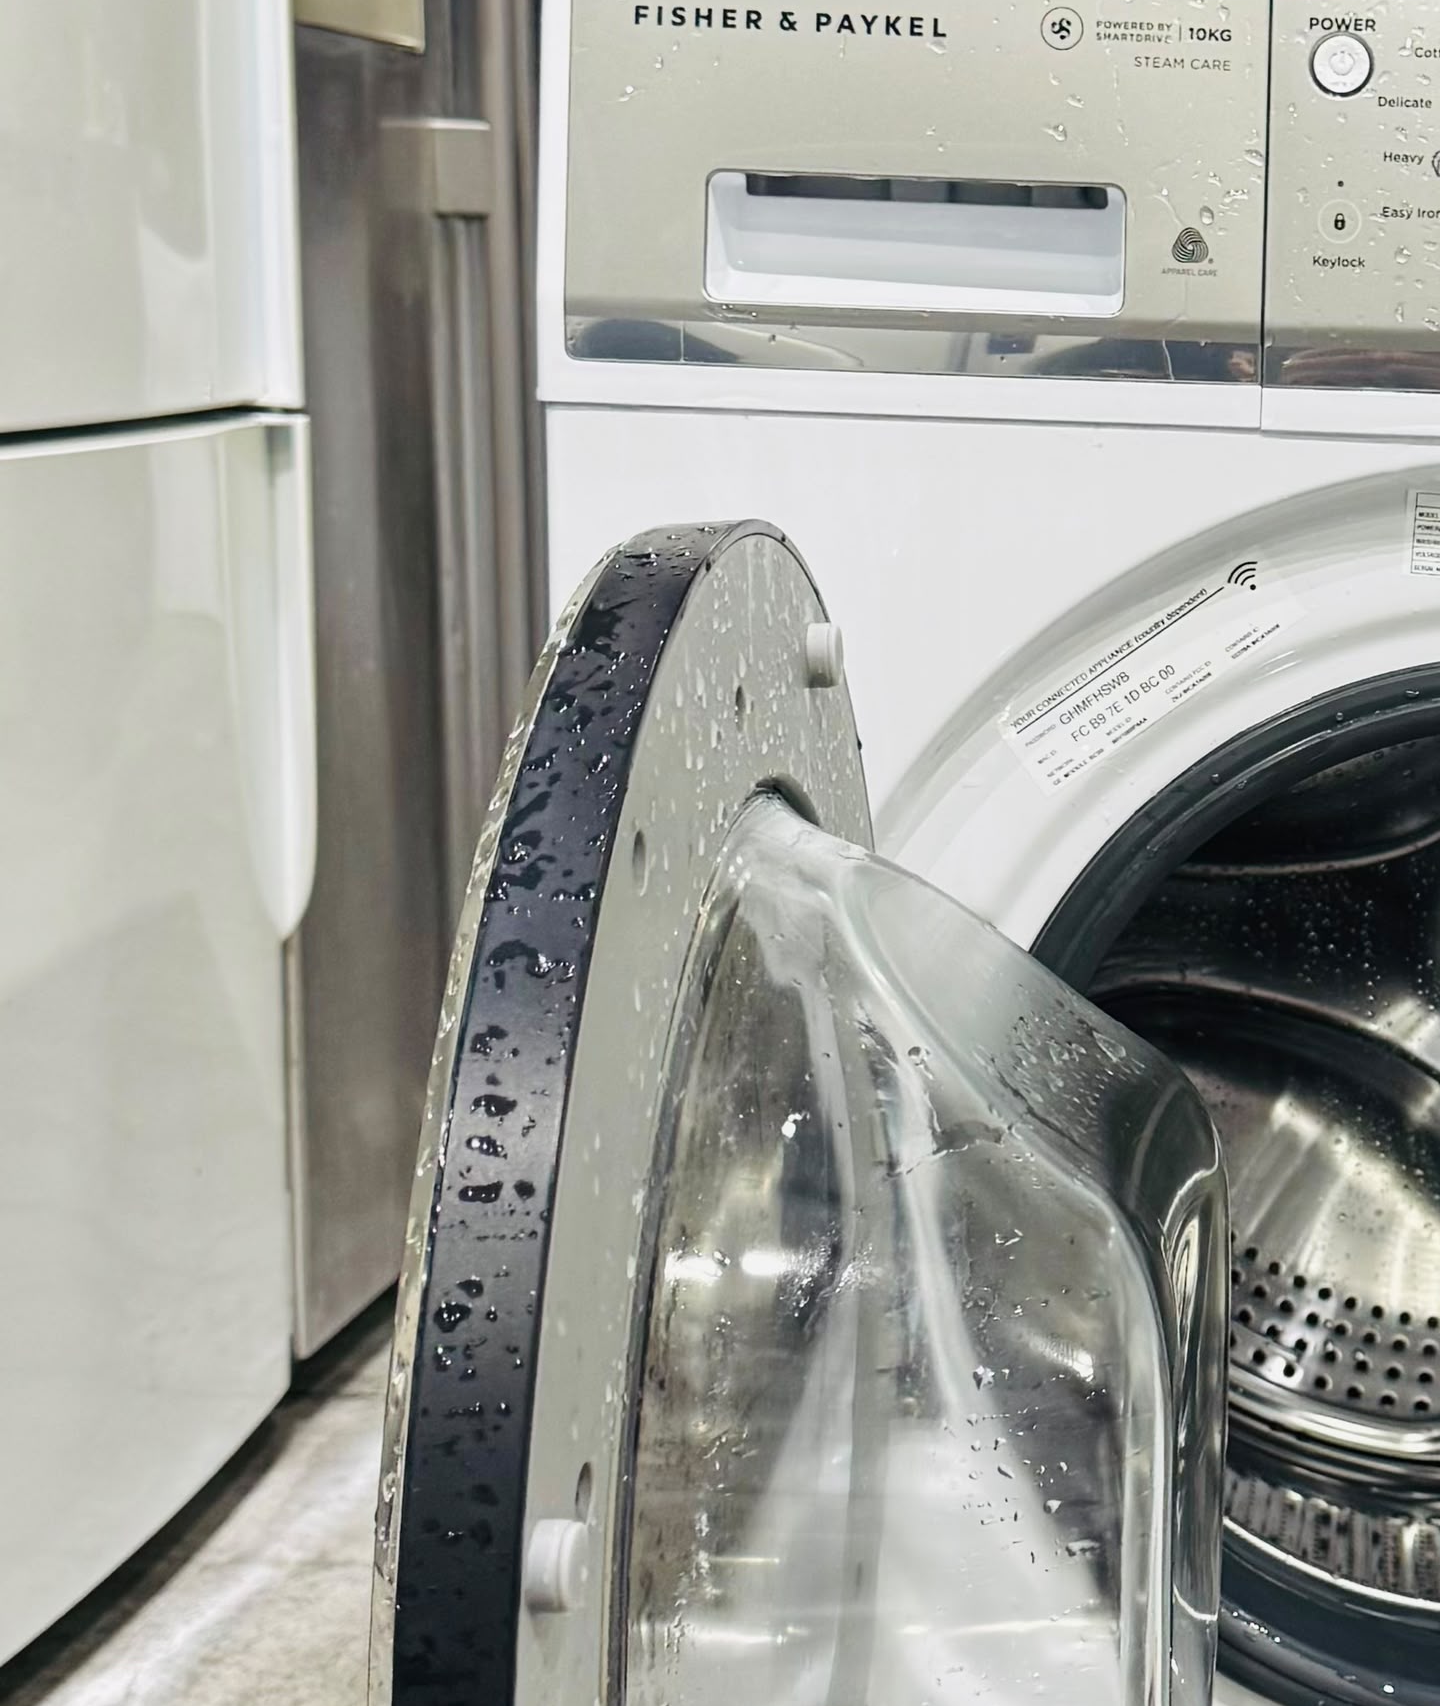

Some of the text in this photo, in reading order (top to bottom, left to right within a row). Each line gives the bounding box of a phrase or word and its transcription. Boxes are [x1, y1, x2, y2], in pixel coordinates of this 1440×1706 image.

[634, 5, 947, 38] FISHER & PAYKEL
[1096, 21, 1173, 32] POWERED BY
[1309, 17, 1376, 32] POWER
[1189, 27, 1232, 42] 10KG
[1134, 56, 1231, 71] STEAM CARE
[1378, 96, 1432, 108] Delicate
[1383, 152, 1424, 165] Heavy
[1382, 206, 1413, 220] Easy
[1313, 256, 1365, 269] Keylock
[1009, 708, 1037, 730] YOUR
[1034, 671, 1088, 712] CONNECTED
[1086, 639, 1134, 675] APPLIANCE
[1070, 723, 1091, 742] FC
[1088, 711, 1108, 730] B9
[1105, 700, 1124, 717] 7E
[1122, 688, 1141, 705] 1D
[1139, 674, 1160, 694] BC
[1157, 663, 1176, 681] 00
